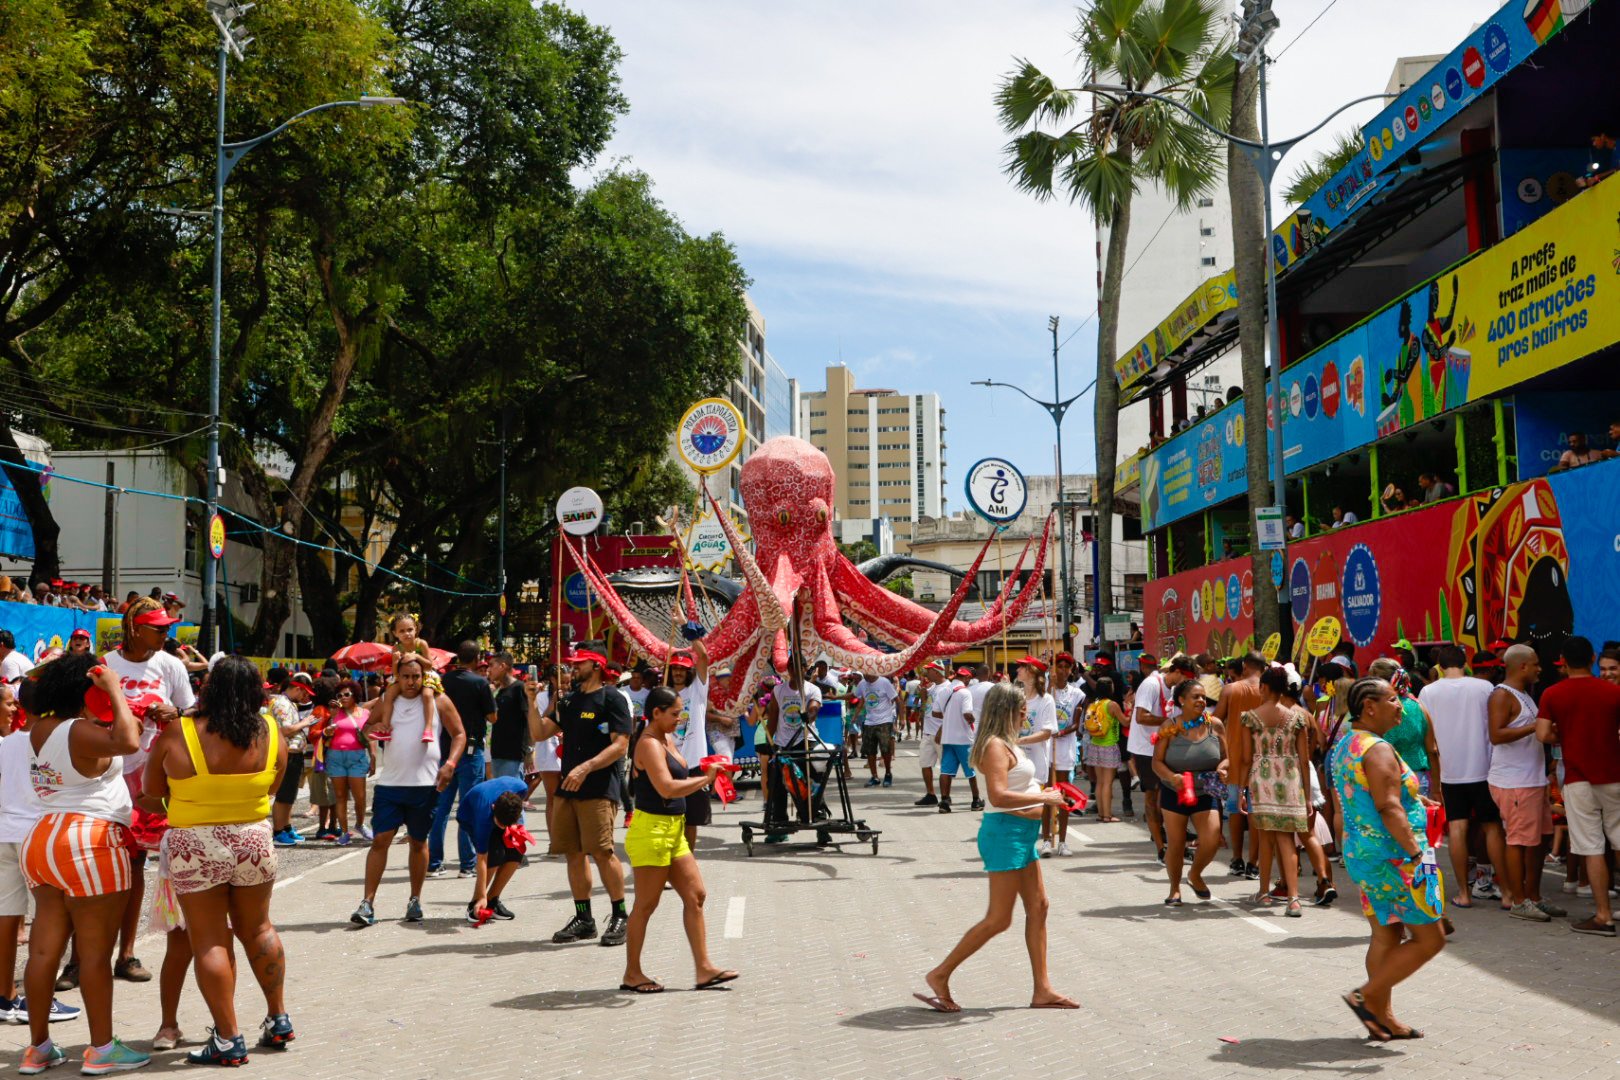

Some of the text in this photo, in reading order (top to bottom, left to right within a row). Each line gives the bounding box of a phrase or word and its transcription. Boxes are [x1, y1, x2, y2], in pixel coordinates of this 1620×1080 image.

[1511, 242, 1556, 281] A Prefs
[1498, 255, 1577, 309] traz mais de
[1487, 274, 1596, 343] 400 atrações
[1498, 309, 1588, 368] pros bairros
[988, 504, 1008, 515] AMI
[1292, 586, 1308, 597] BEATS
[1316, 582, 1336, 601] BRAHMA
[1347, 593, 1374, 608] SALVADOR
